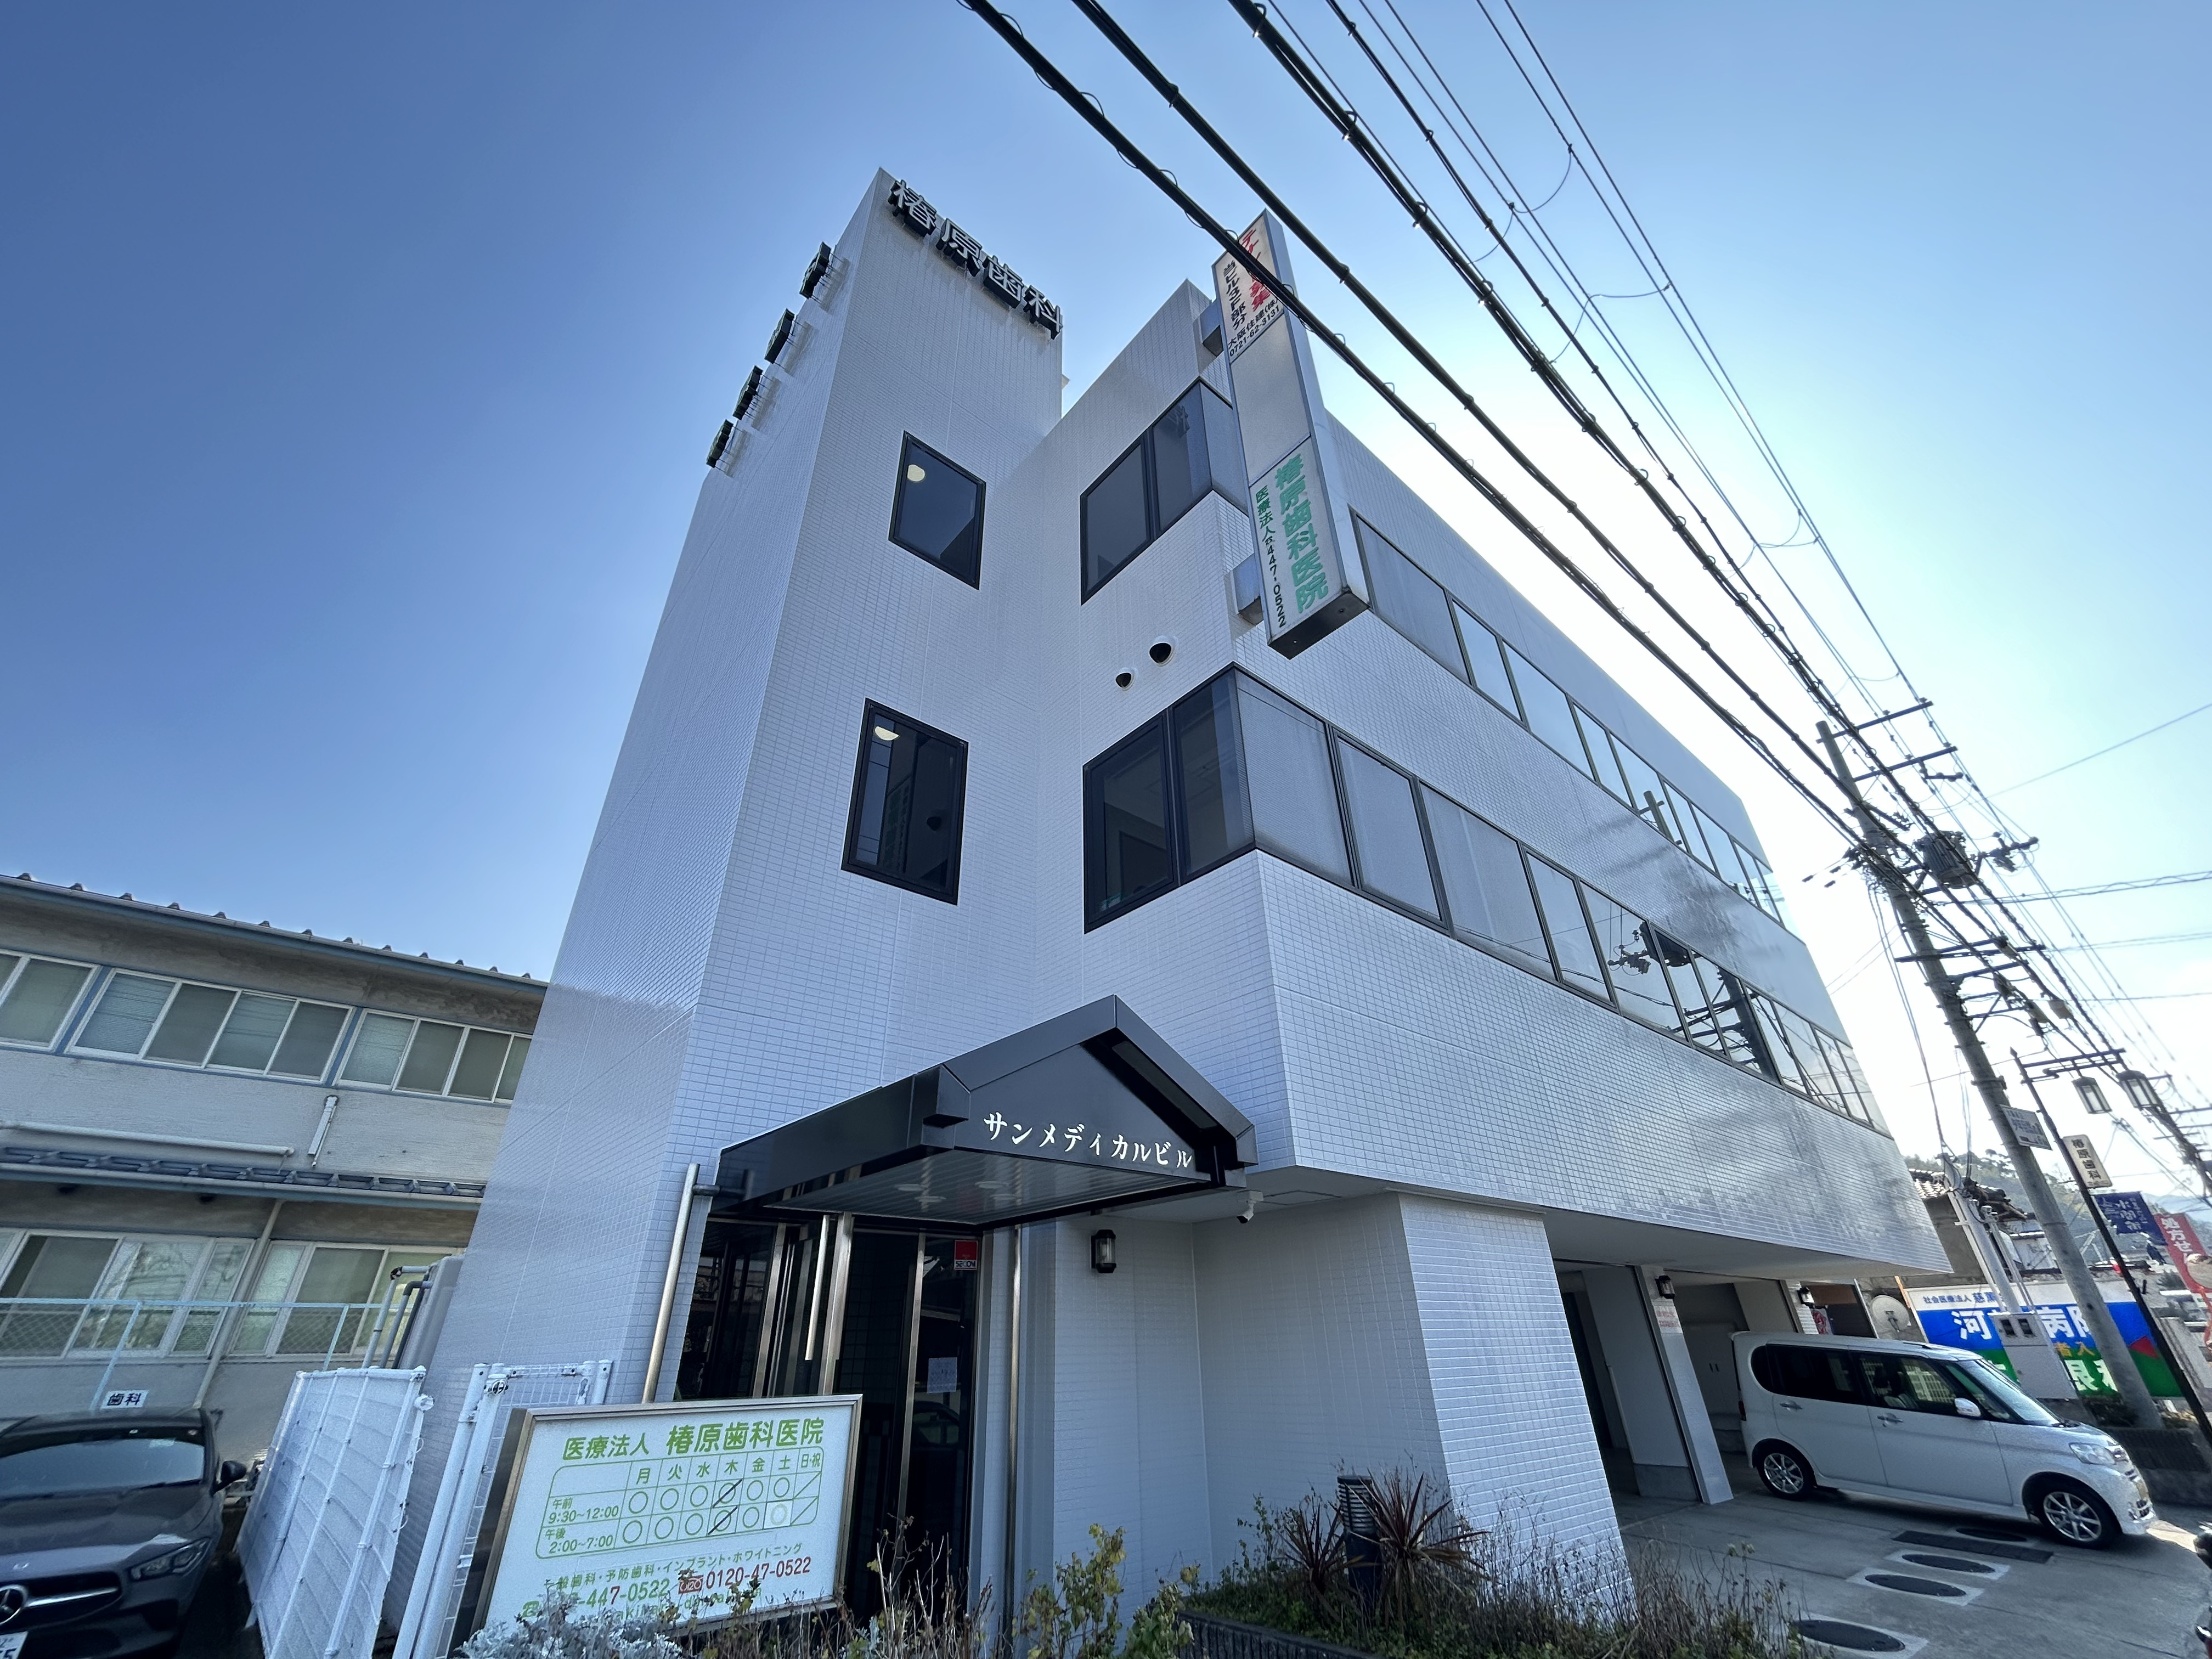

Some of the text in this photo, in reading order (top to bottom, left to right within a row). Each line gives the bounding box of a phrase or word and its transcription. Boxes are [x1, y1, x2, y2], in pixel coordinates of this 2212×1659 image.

[888, 179, 1063, 340] 椿原歯科
[1223, 259, 1246, 330] 当ビル3F部分
[1229, 304, 1280, 357] 0721-62-3131
[1256, 484, 1276, 542] 医療法人
[1275, 453, 1328, 613] 椿原歯科医院
[984, 1111, 1193, 1169] サンメディカルビル
[107, 1393, 142, 1406] 歯科
[562, 1417, 824, 1460] 医療法人 椿原歯科医院
[636, 1468, 651, 1485] 月
[667, 1463, 682, 1481] 火
[696, 1462, 711, 1477] 水
[724, 1459, 738, 1475] 木
[752, 1457, 765, 1473] 金
[778, 1455, 791, 1470] 土
[552, 1497, 573, 1510] 午前
[545, 1527, 566, 1540] 午後
[706, 1556, 811, 1589] 0120-47-0522
